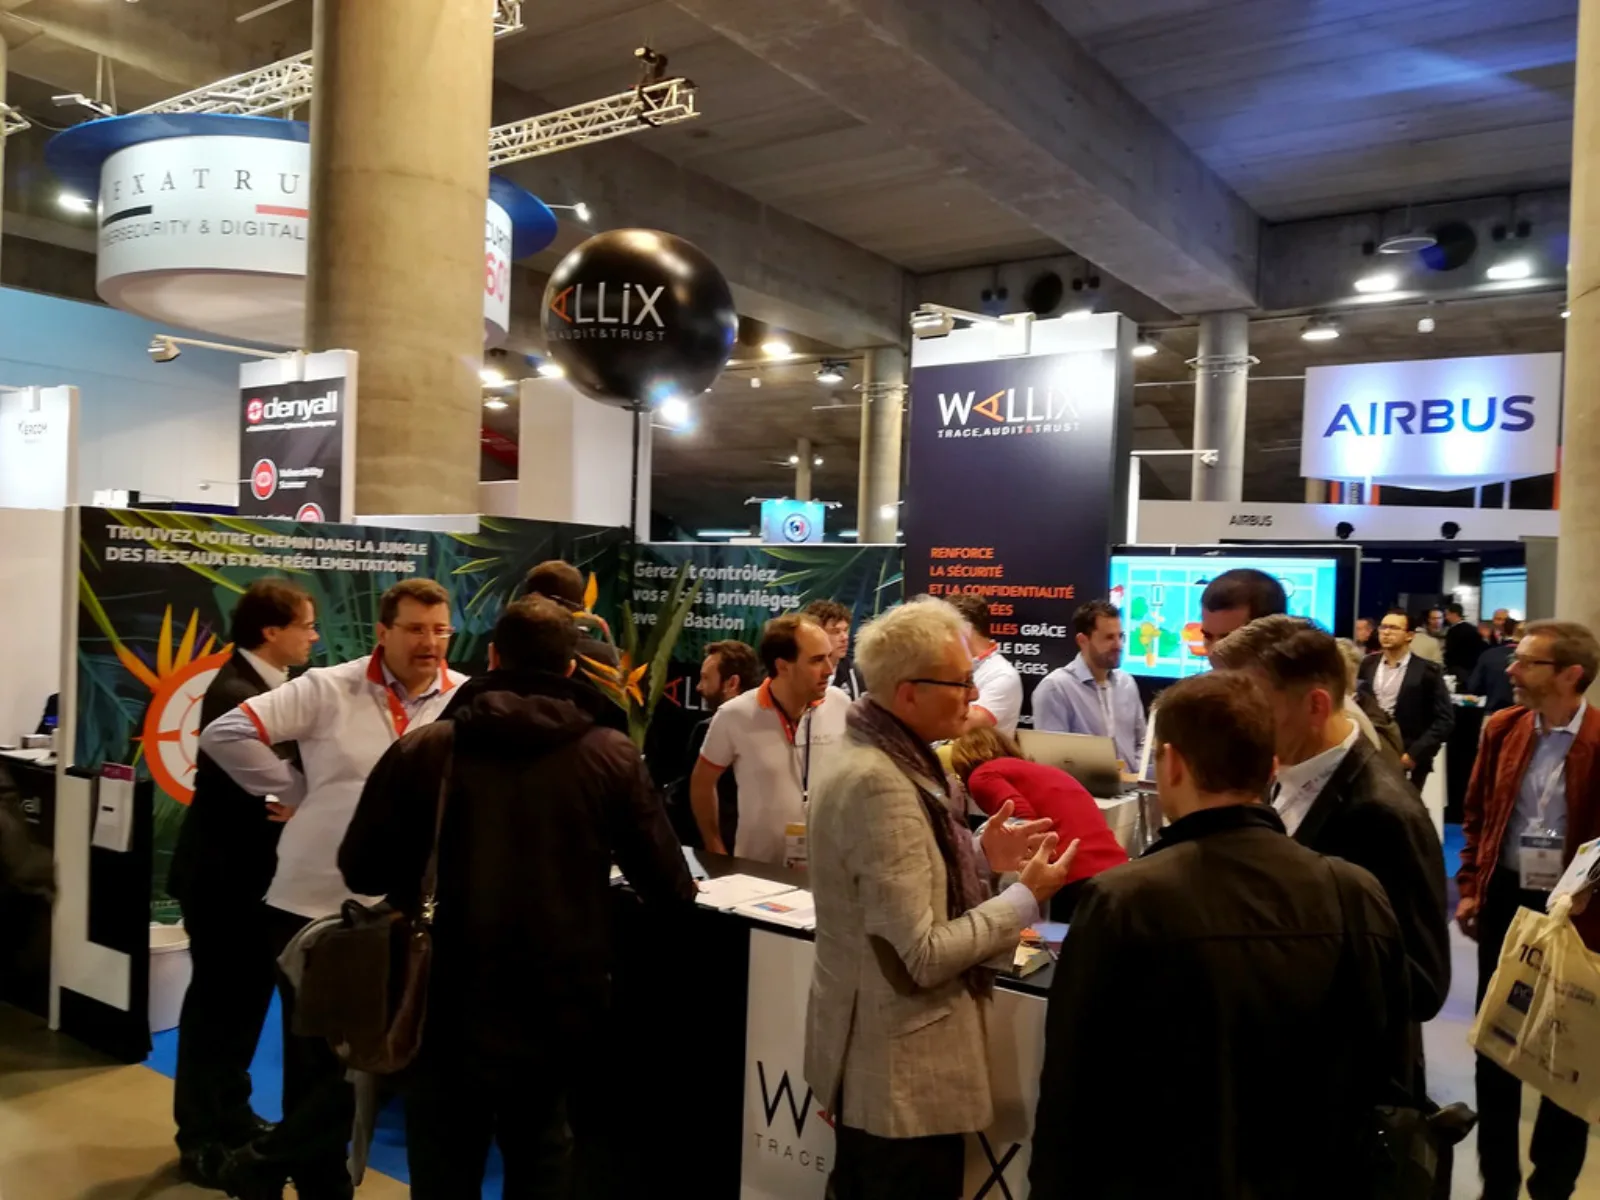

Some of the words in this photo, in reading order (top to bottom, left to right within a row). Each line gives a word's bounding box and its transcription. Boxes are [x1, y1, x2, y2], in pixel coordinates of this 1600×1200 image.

[199, 219, 210, 234] &
[220, 219, 305, 240] DIGITAL
[263, 391, 337, 420] denyall
[1323, 394, 1535, 438] AIRBUS
[1229, 514, 1272, 527] AIRBUS
[106, 525, 192, 543] TROUVEZ
[196, 531, 250, 546] VOTRE
[252, 534, 313, 549] CHEMIN
[315, 537, 355, 551] DANS
[356, 540, 374, 552] LA
[376, 542, 428, 555] JUNGLE
[105, 547, 143, 561] DES
[145, 547, 226, 565] RÉSEAUX
[226, 553, 247, 565] ET
[249, 554, 281, 567] DES
[931, 547, 994, 559] RENFORCE
[633, 562, 678, 579] Gérez
[699, 564, 778, 582] contrôlez
[929, 565, 945, 577] LA
[947, 564, 1004, 578] SÉCURITÉ
[632, 589, 657, 602] vos
[704, 587, 715, 604] à
[717, 589, 800, 613] privilèges
[929, 583, 944, 595] ET
[945, 584, 961, 595] LA
[962, 584, 1075, 599] CONFIDENTIALITÉ
[683, 611, 745, 631] Bastion
[1020, 622, 1067, 638] GRÂCE
[1014, 643, 1040, 656] DES
